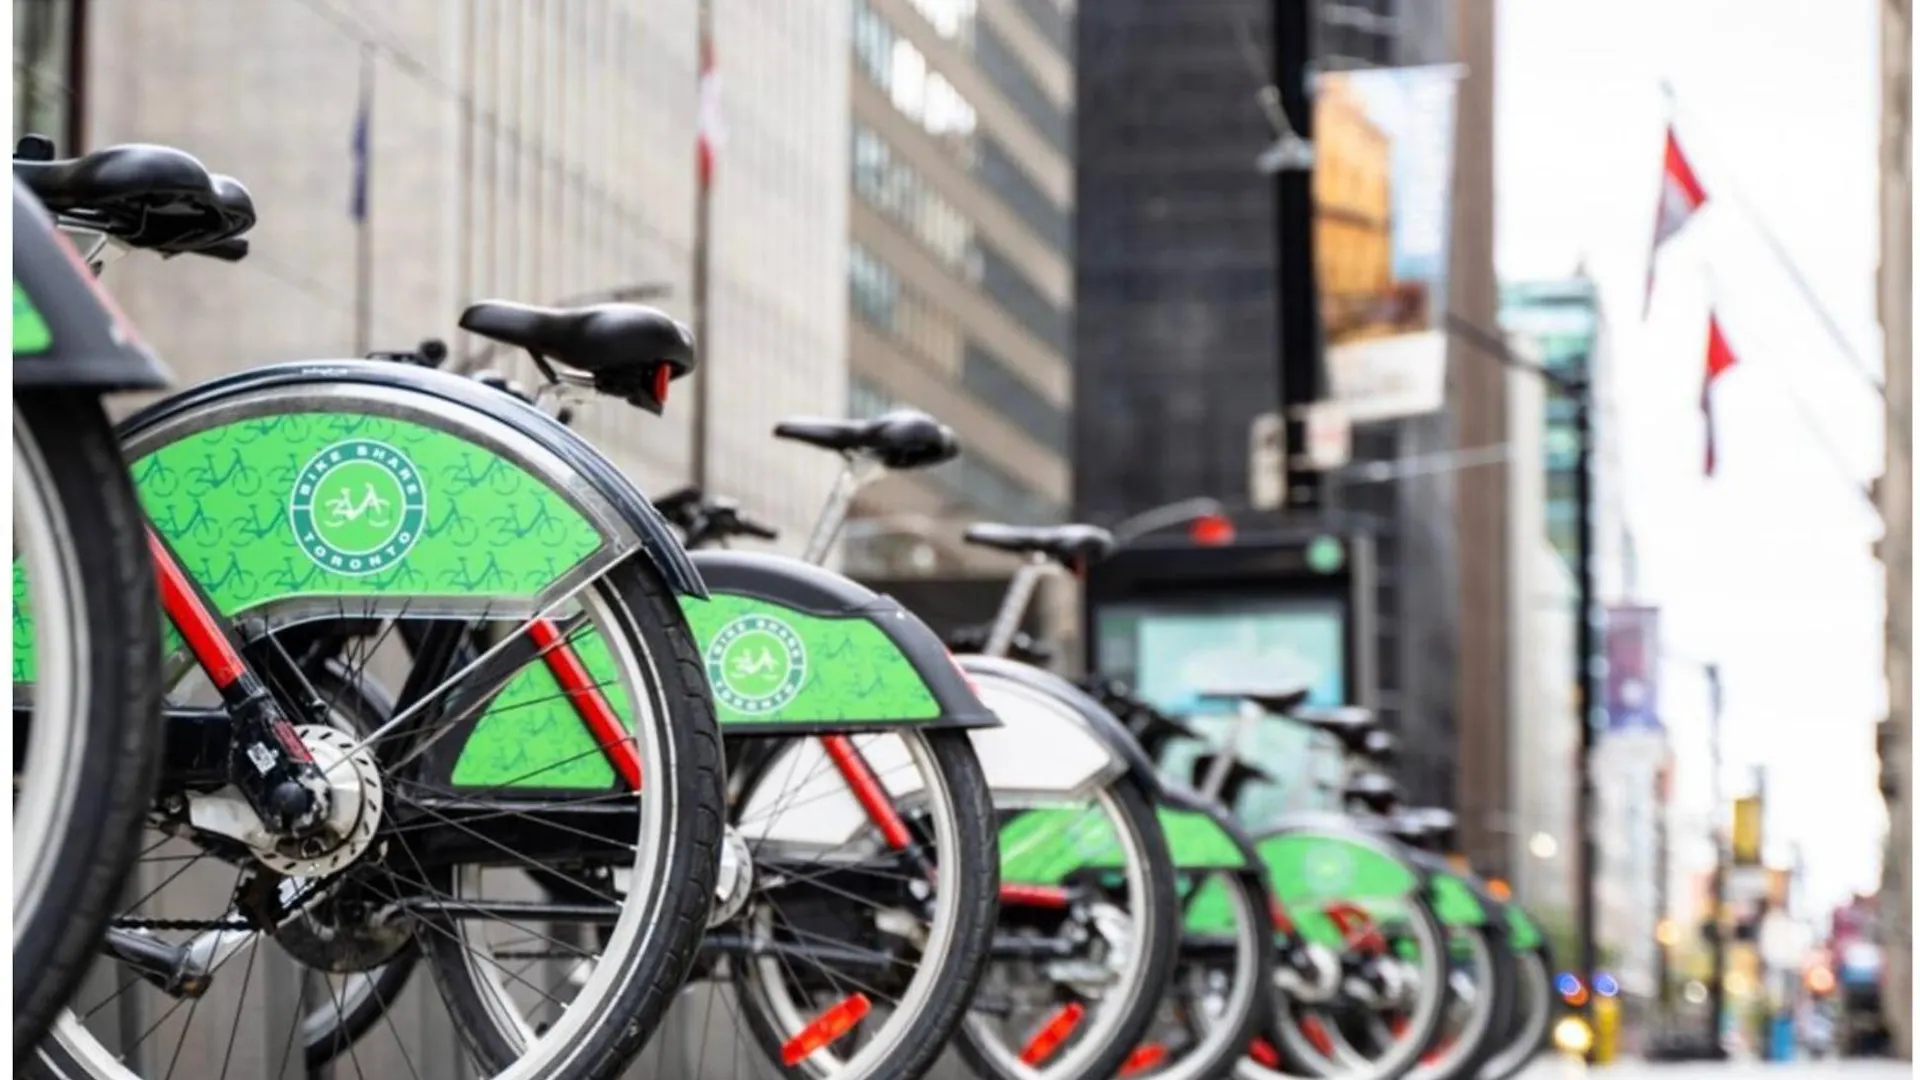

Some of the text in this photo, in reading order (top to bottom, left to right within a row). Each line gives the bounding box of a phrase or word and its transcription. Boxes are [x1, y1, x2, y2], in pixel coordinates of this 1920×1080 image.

[300, 445, 419, 495] BIKE SHARE
[303, 532, 411, 569] TORONTO
